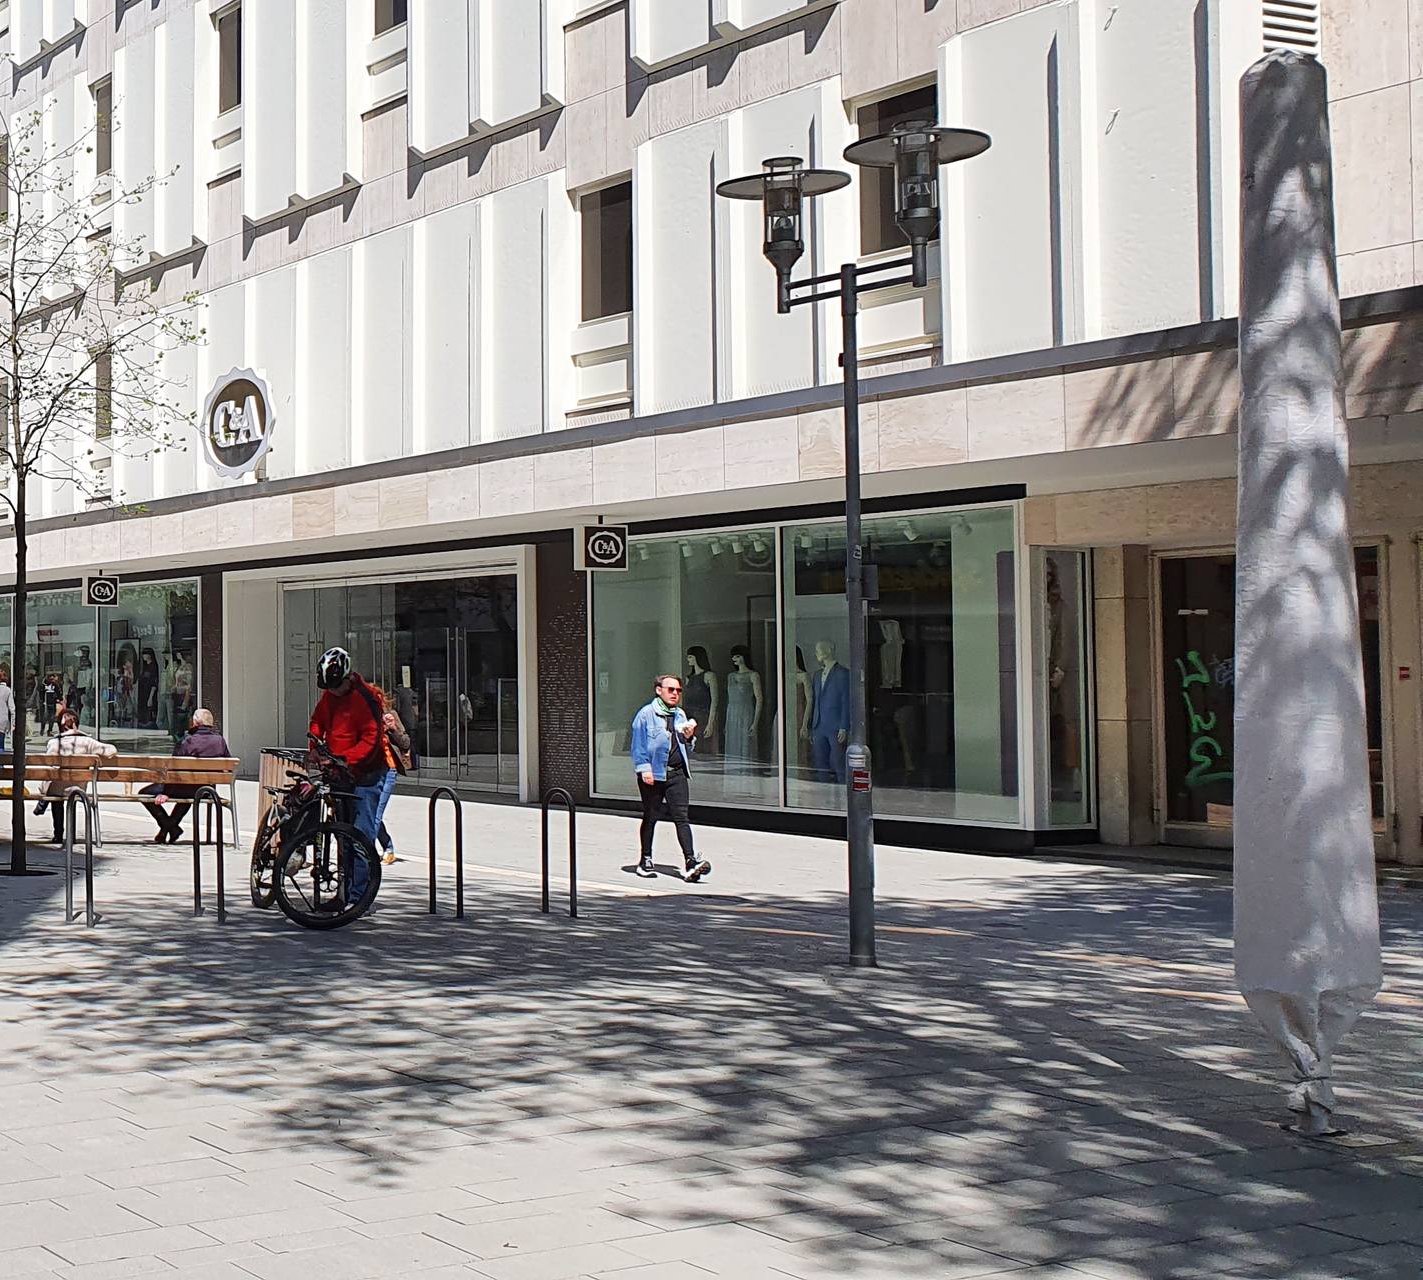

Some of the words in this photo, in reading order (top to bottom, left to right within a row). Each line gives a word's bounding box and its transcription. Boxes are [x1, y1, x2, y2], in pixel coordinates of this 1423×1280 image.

[213, 395, 263, 448] C&A
[594, 540, 617, 554] C&A
[94, 586, 111, 597] C&A
